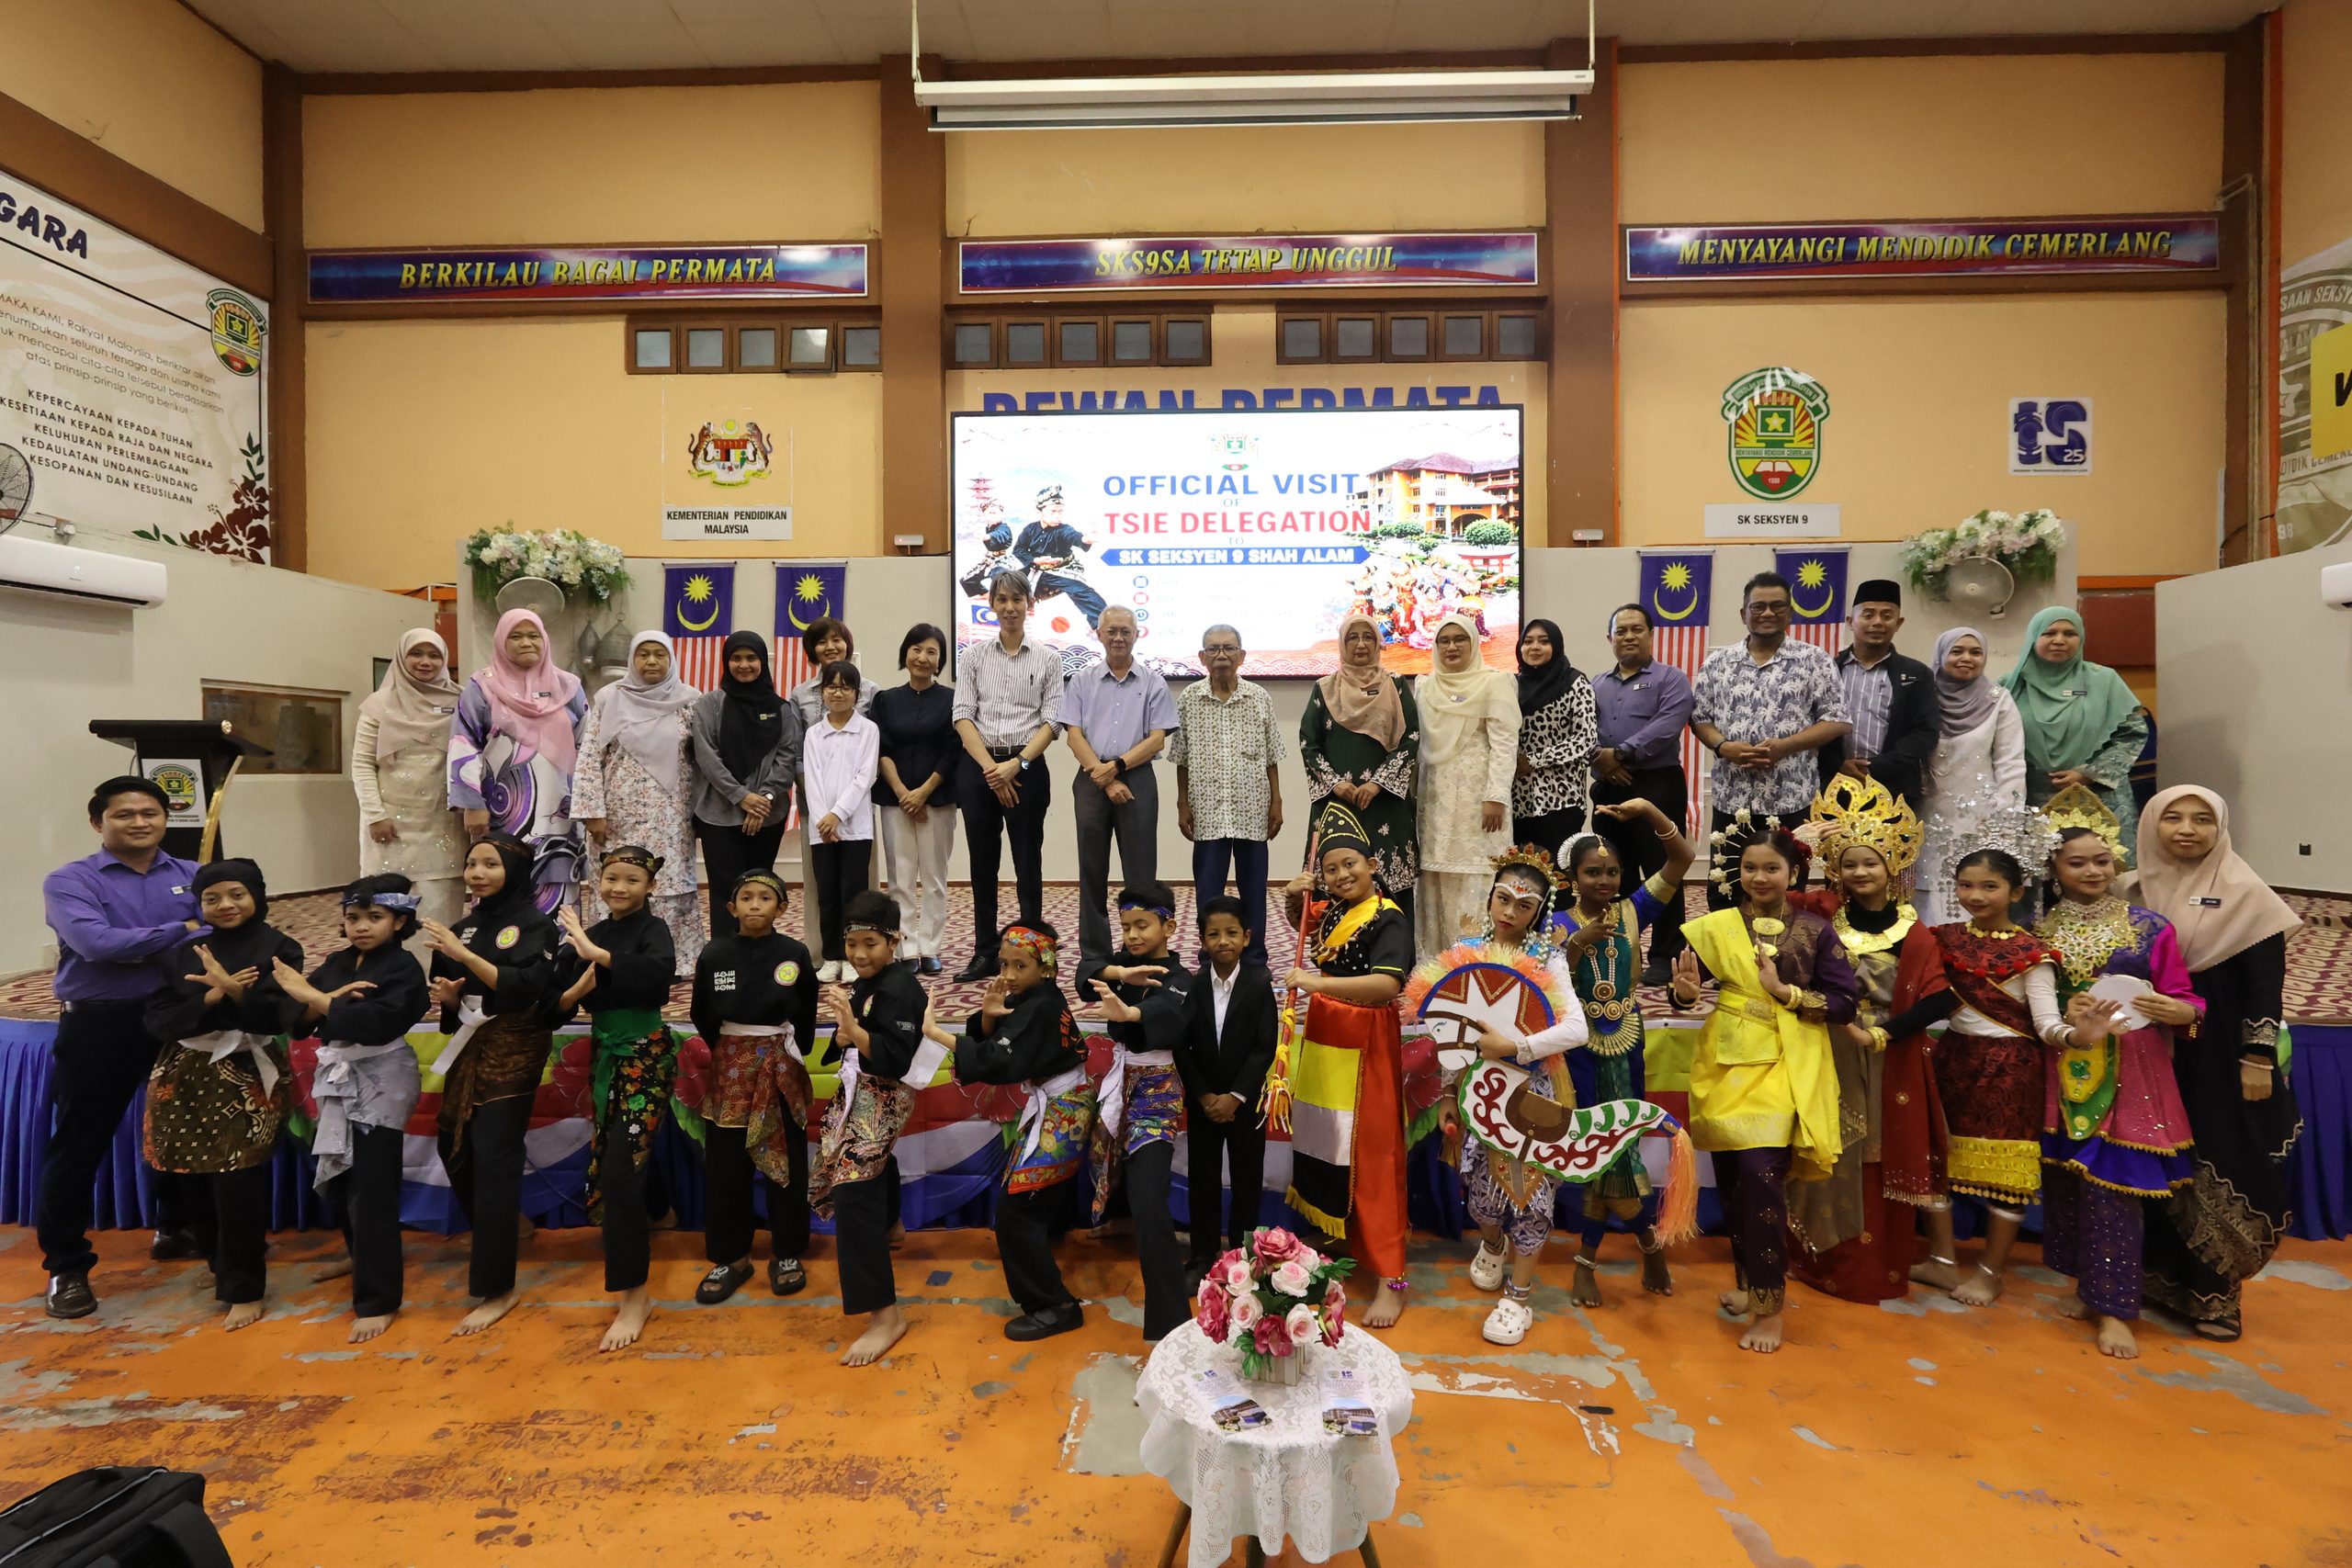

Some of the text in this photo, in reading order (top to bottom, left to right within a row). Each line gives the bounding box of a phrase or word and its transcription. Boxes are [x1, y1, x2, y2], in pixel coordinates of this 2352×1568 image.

[0, 192, 87, 259] GARA
[1095, 246, 1396, 276] SKS9SA TETAP UNGGUL
[1679, 231, 2172, 265] MENYAYANGI MENDIDIK CEMERLANG
[400, 257, 777, 288] BERKILAU BAGAI PERMATA
[68, 319, 104, 341] Rakyat
[18, 333, 78, 361] mencapai
[81, 356, 124, 378] cita-cita
[128, 373, 165, 393] tersebut
[70, 337, 107, 357] seluruh
[111, 352, 148, 371] tenaga
[150, 367, 169, 380] dan
[26, 352, 51, 367] atas
[130, 389, 154, 404] yang
[0, 396, 213, 468] KESETIAAN KEPADA RAJA DAN NEGARA
[28, 389, 193, 448] KEPERCAYAAN KEPADA TUHAN
[22, 436, 198, 491] KEDAULATAN UNDANG-UNDANG
[34, 423, 188, 475] KELUHURAN PERLEMBAGAAN
[2064, 448, 2085, 462] 25
[29, 454, 193, 504] KESOPANAN DAN KESUSILAAN
[1103, 473, 1359, 495] OFFICIAL VISIT
[667, 511, 787, 520] KEMENTERIAN PENDIDIKAN
[1223, 498, 1241, 507] OF
[704, 525, 749, 534] MALAYSIA
[1104, 511, 1371, 534] TSIE DELEGATION
[1737, 514, 1808, 525] SK SEKSYEN 9
[1119, 548, 1354, 564] SK SEKSYEN 9 SHAH ALAM
